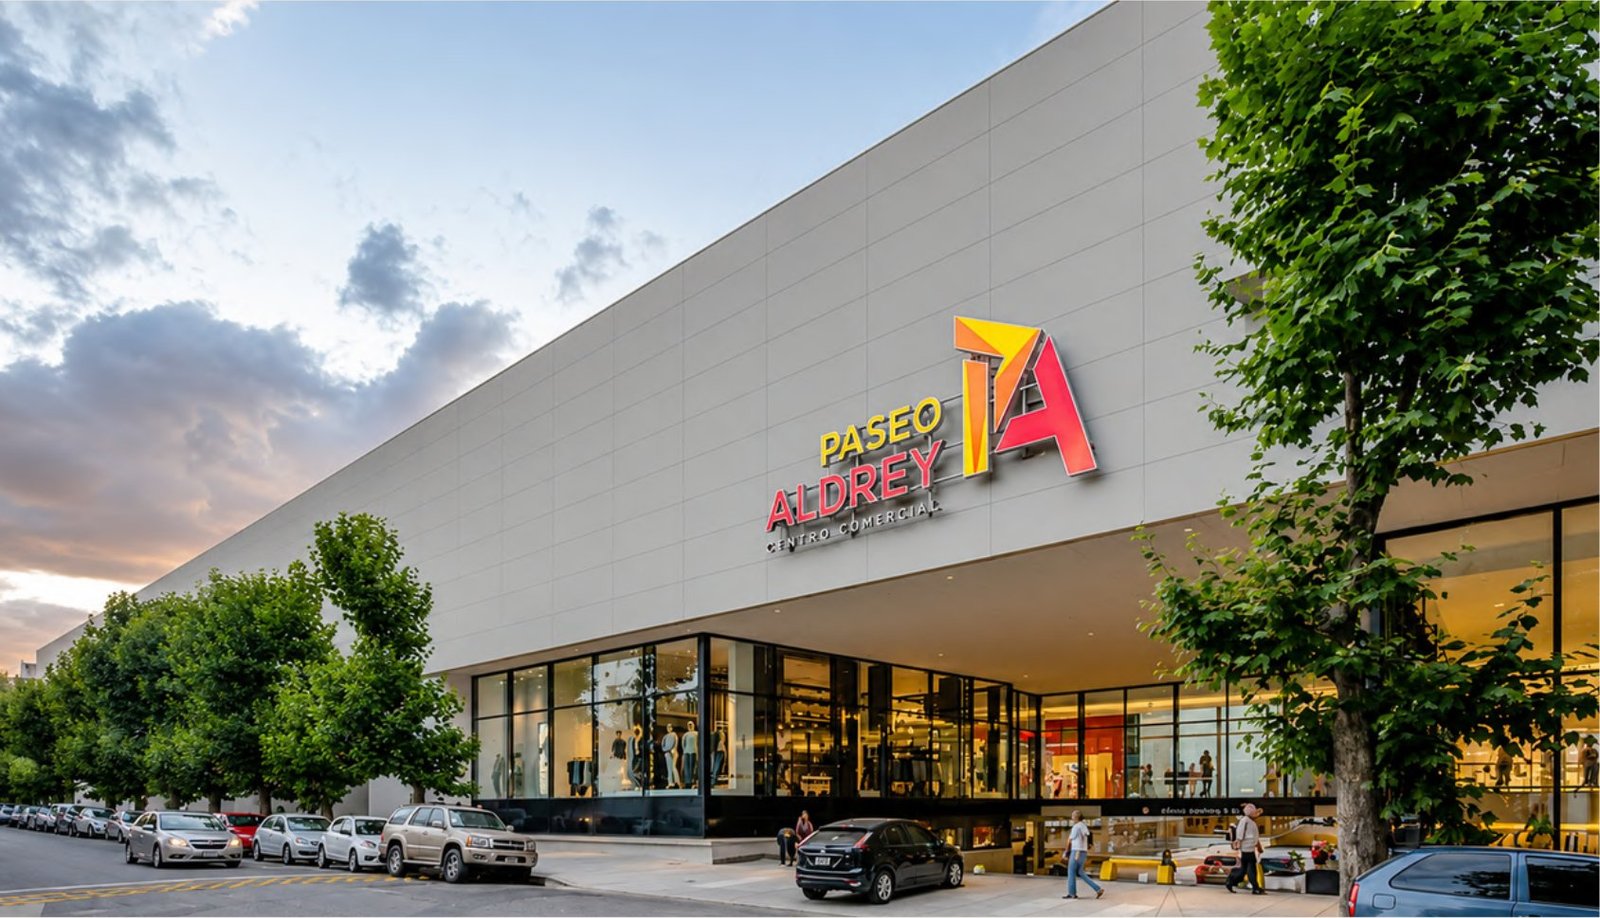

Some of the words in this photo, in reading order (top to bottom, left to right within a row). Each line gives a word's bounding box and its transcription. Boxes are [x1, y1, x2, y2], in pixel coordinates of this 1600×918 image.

[820, 396, 943, 467] PASEO
[765, 441, 944, 533] ALDREY
[766, 529, 829, 553] CENTRO
[839, 500, 942, 535] COMERCIAL
